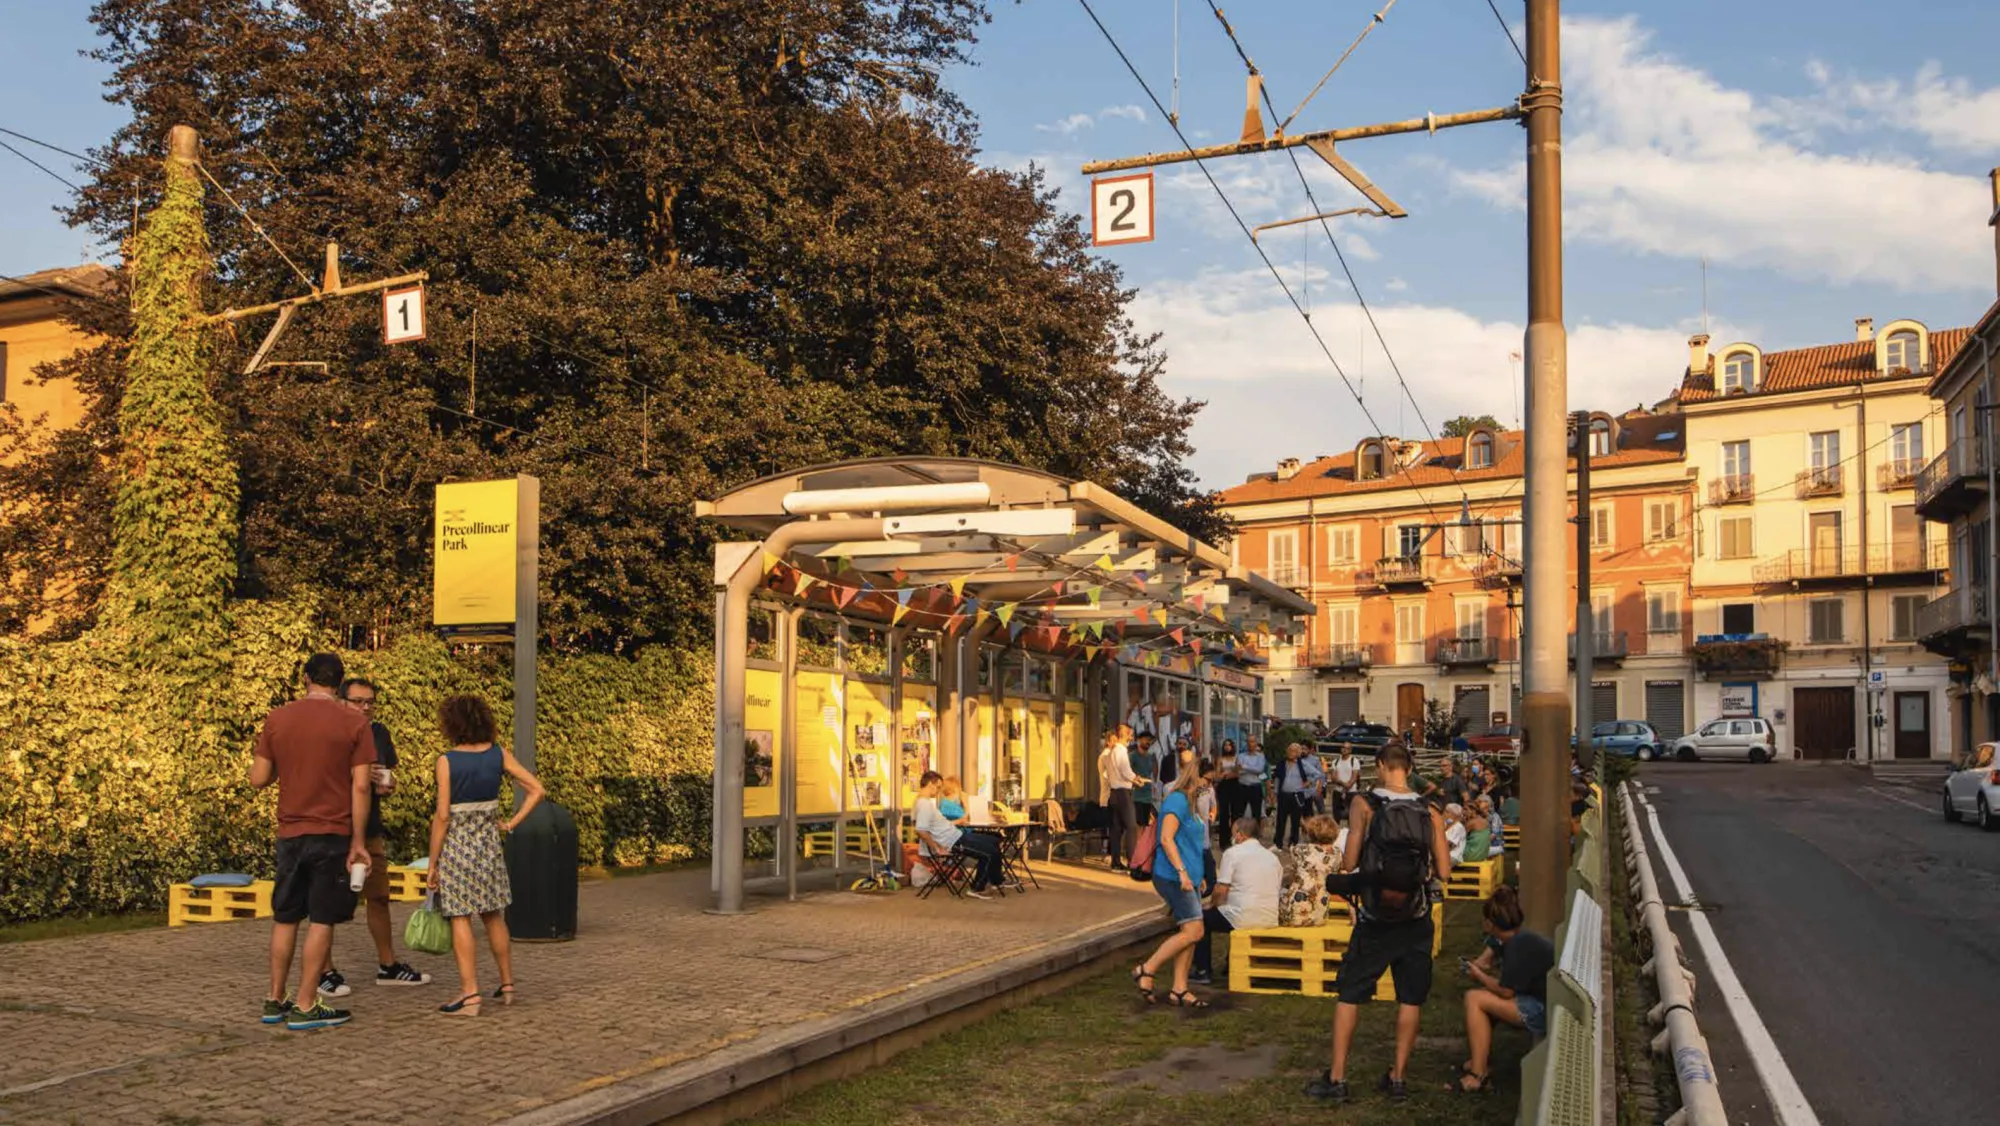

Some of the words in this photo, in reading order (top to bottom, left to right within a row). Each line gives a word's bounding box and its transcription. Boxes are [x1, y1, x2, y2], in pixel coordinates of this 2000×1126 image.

[1109, 189, 1136, 232] 2
[398, 299, 409, 331] 1
[443, 521, 510, 537] Precollinear
[443, 537, 468, 551] Park
